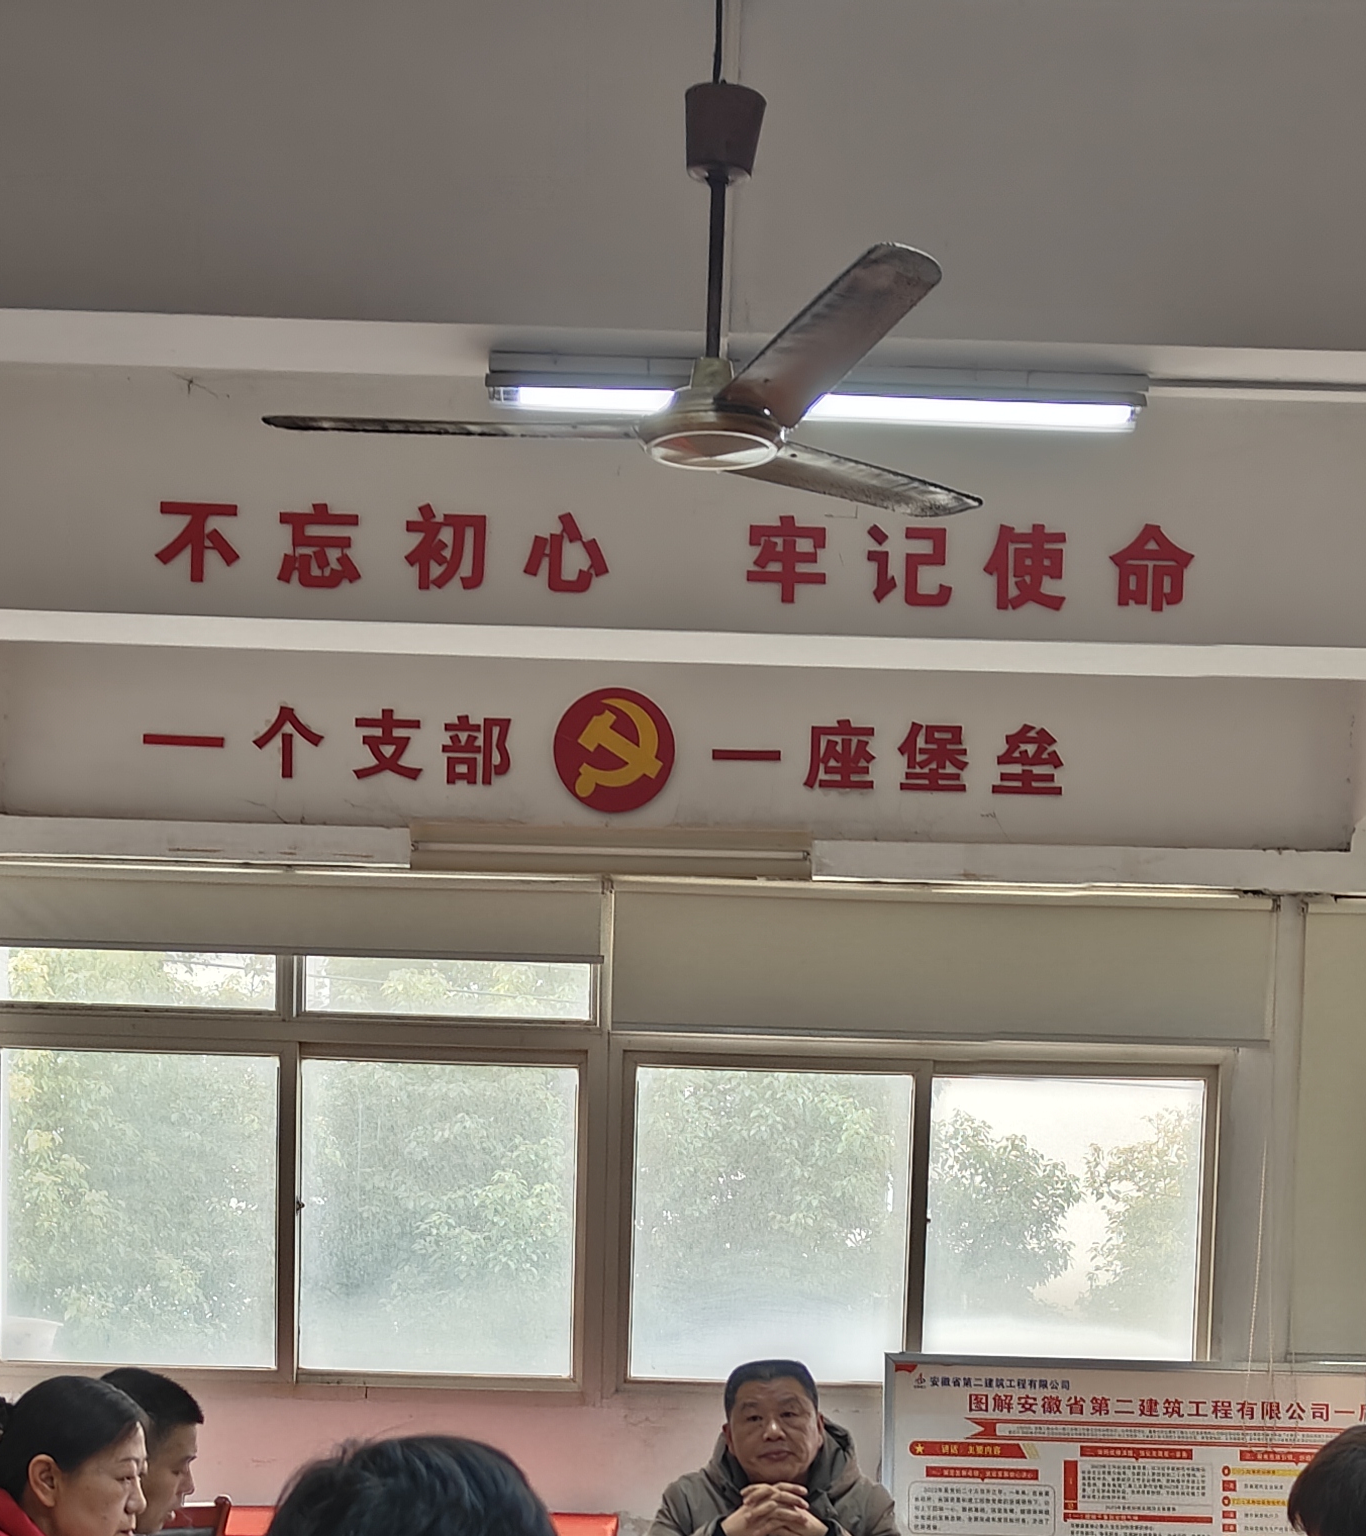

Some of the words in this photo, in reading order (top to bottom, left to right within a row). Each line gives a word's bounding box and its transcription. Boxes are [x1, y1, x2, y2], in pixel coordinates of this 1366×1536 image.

[155, 501, 609, 593] 不忘初心
[746, 515, 1195, 612] 牢记使命
[143, 706, 512, 786] 一个支部
[712, 719, 1065, 796] 一座堡垒
